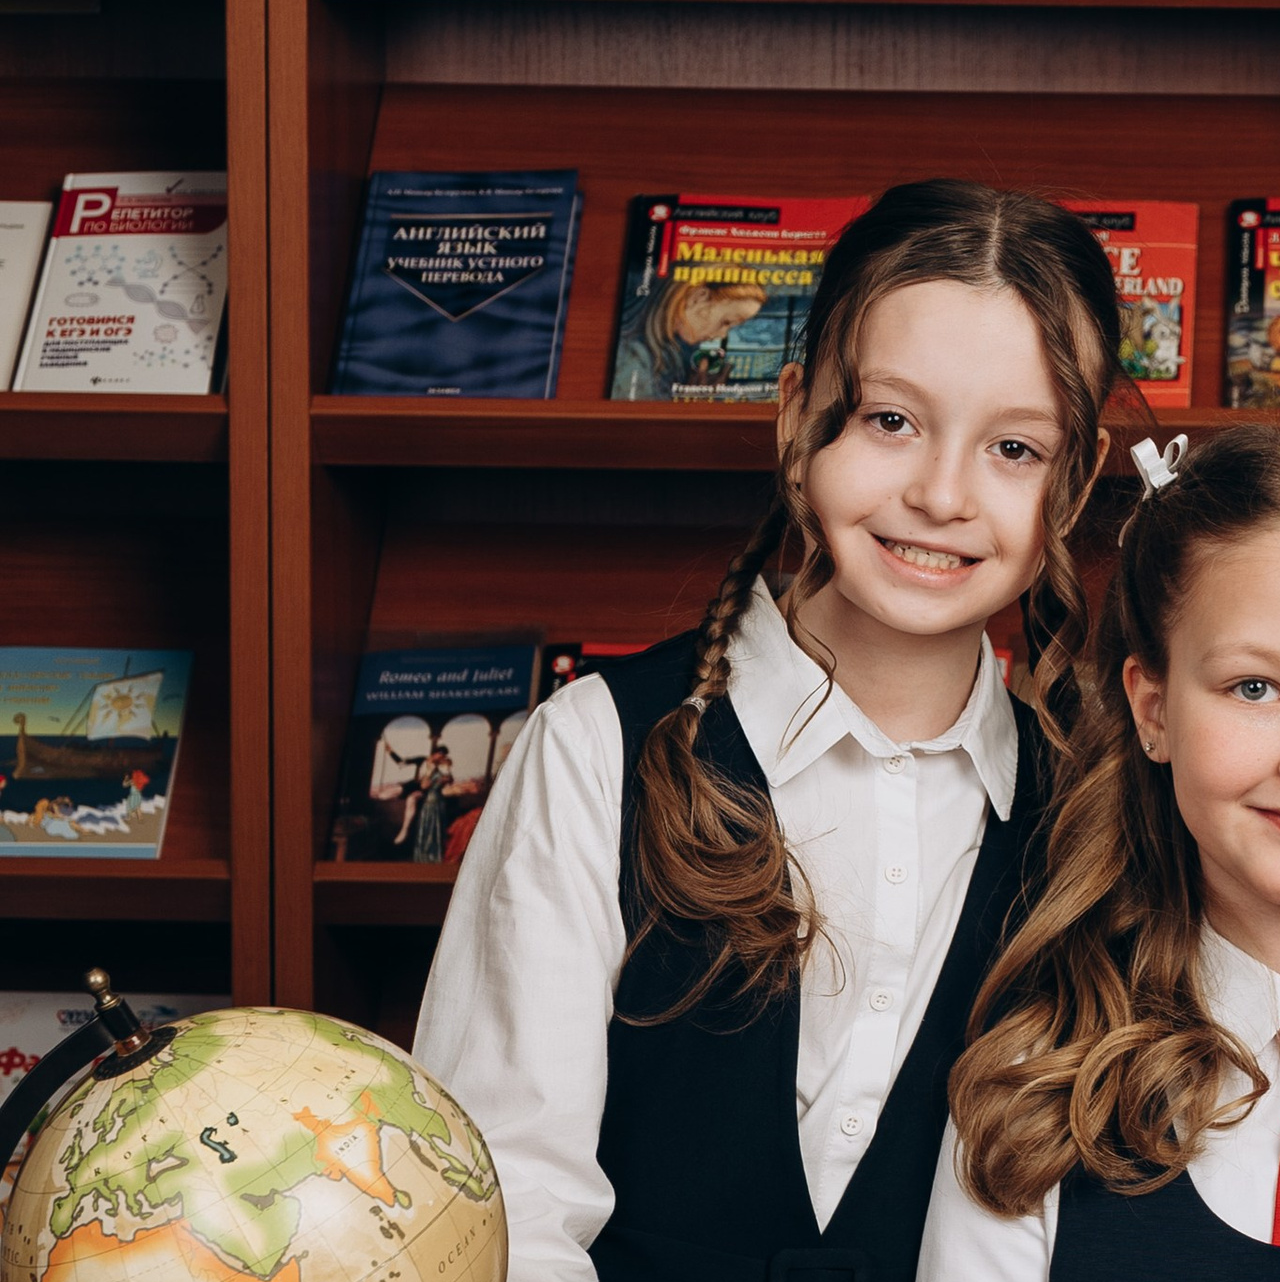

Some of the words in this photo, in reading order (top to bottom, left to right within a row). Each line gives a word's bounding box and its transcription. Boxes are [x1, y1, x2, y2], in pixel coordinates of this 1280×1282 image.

[83, 220, 108, 233] ПО
[109, 219, 194, 233] БИОЛОГИИ
[392, 222, 548, 241] АНГЛИЙСКИЙ
[436, 241, 498, 256] ЯЗЫК
[676, 241, 825, 265] Маленькая
[387, 256, 464, 270] УЧЕБНИК
[468, 255, 544, 269] УСТНОГО
[420, 271, 505, 285] ПЕРЕВОДА
[673, 265, 814, 286] принцесса
[1114, 276, 1184, 297] ERLAND
[47, 315, 136, 327] ГОТОВИМСЯ
[46, 329, 56, 338] К
[59, 328, 86, 338] ЕГЭ
[90, 328, 100, 337] И
[103, 327, 133, 337] ОГЭ
[378, 669, 432, 685] Romeo
[436, 670, 468, 683] and
[472, 666, 515, 684] Juliet
[365, 689, 424, 702] WILLIAM
[427, 684, 521, 701] SHAKESPEARE
[334, 1133, 359, 1157] INDIA
[438, 1225, 476, 1274] OCEAN
